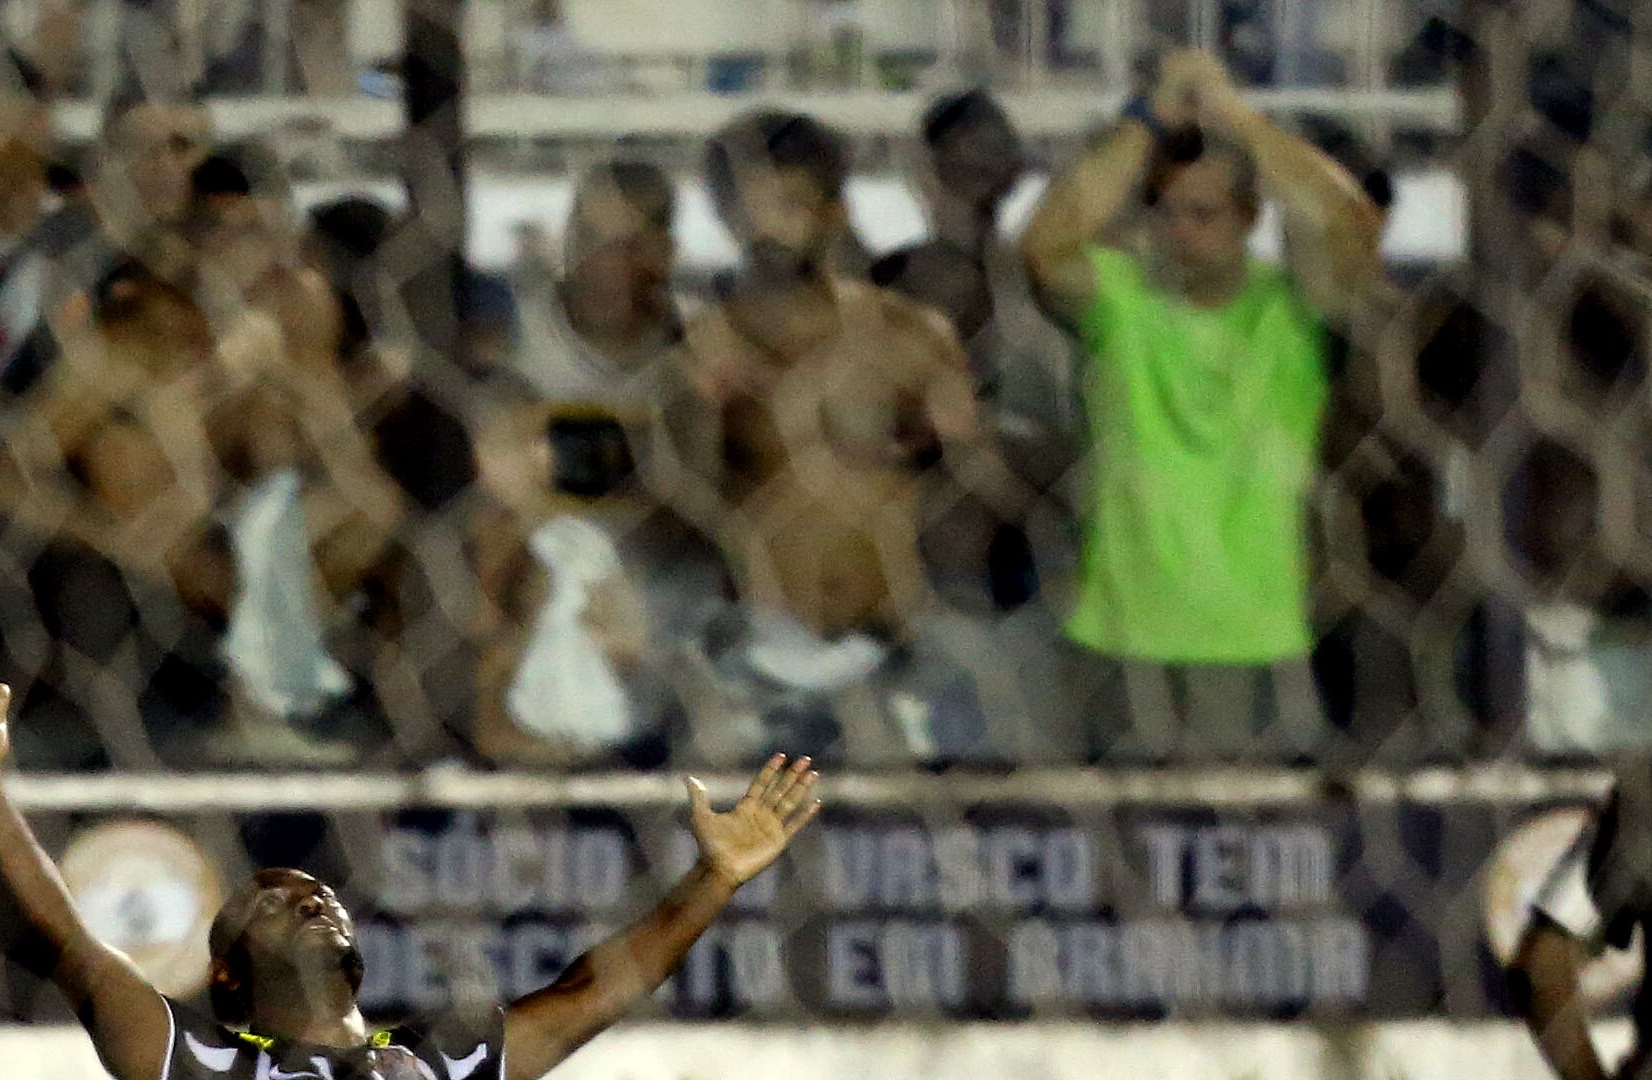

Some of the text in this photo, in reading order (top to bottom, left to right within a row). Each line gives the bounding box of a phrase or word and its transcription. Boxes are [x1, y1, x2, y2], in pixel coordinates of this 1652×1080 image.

[825, 826, 1094, 907] VASCO
[1144, 826, 1331, 906] TEM
[827, 922, 963, 1004] EM
